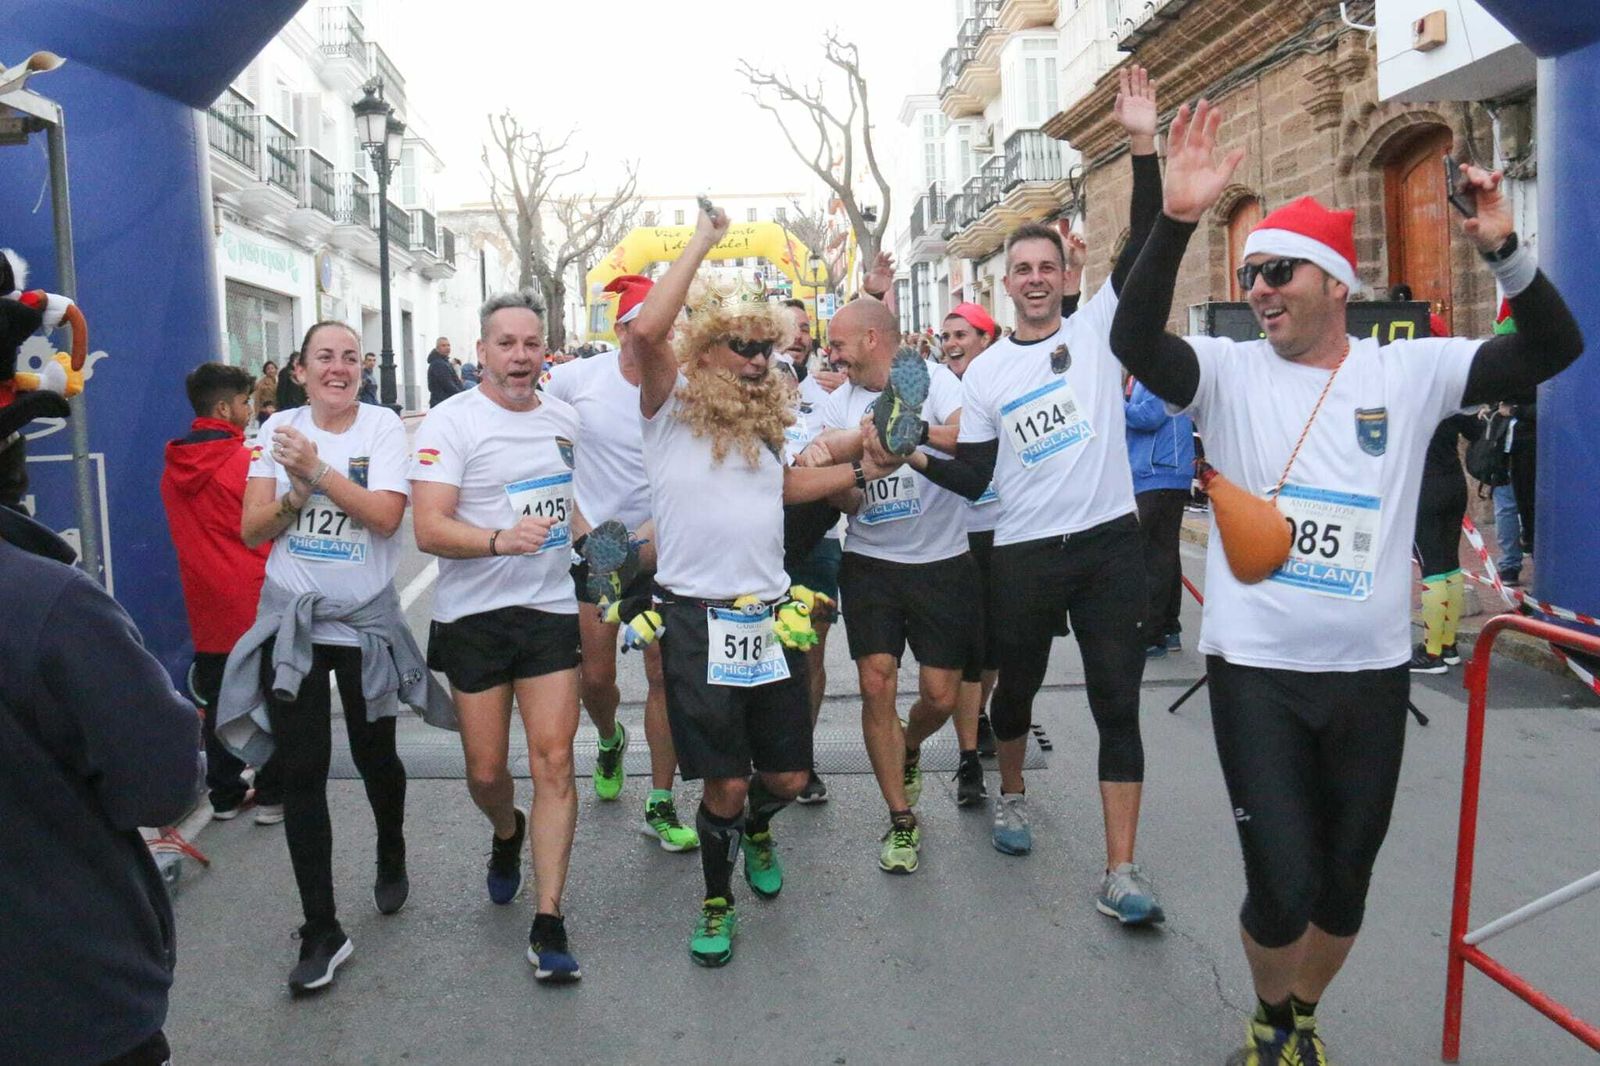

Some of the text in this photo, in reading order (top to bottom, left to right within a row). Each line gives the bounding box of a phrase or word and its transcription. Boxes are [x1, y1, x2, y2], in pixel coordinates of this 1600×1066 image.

[1014, 403, 1066, 444] 1124
[1020, 423, 1091, 466] CHICLANA
[296, 507, 349, 536] 1127
[287, 536, 364, 561] CHICLANA
[724, 633, 762, 661] 518
[710, 660, 787, 680] CHICLANA
